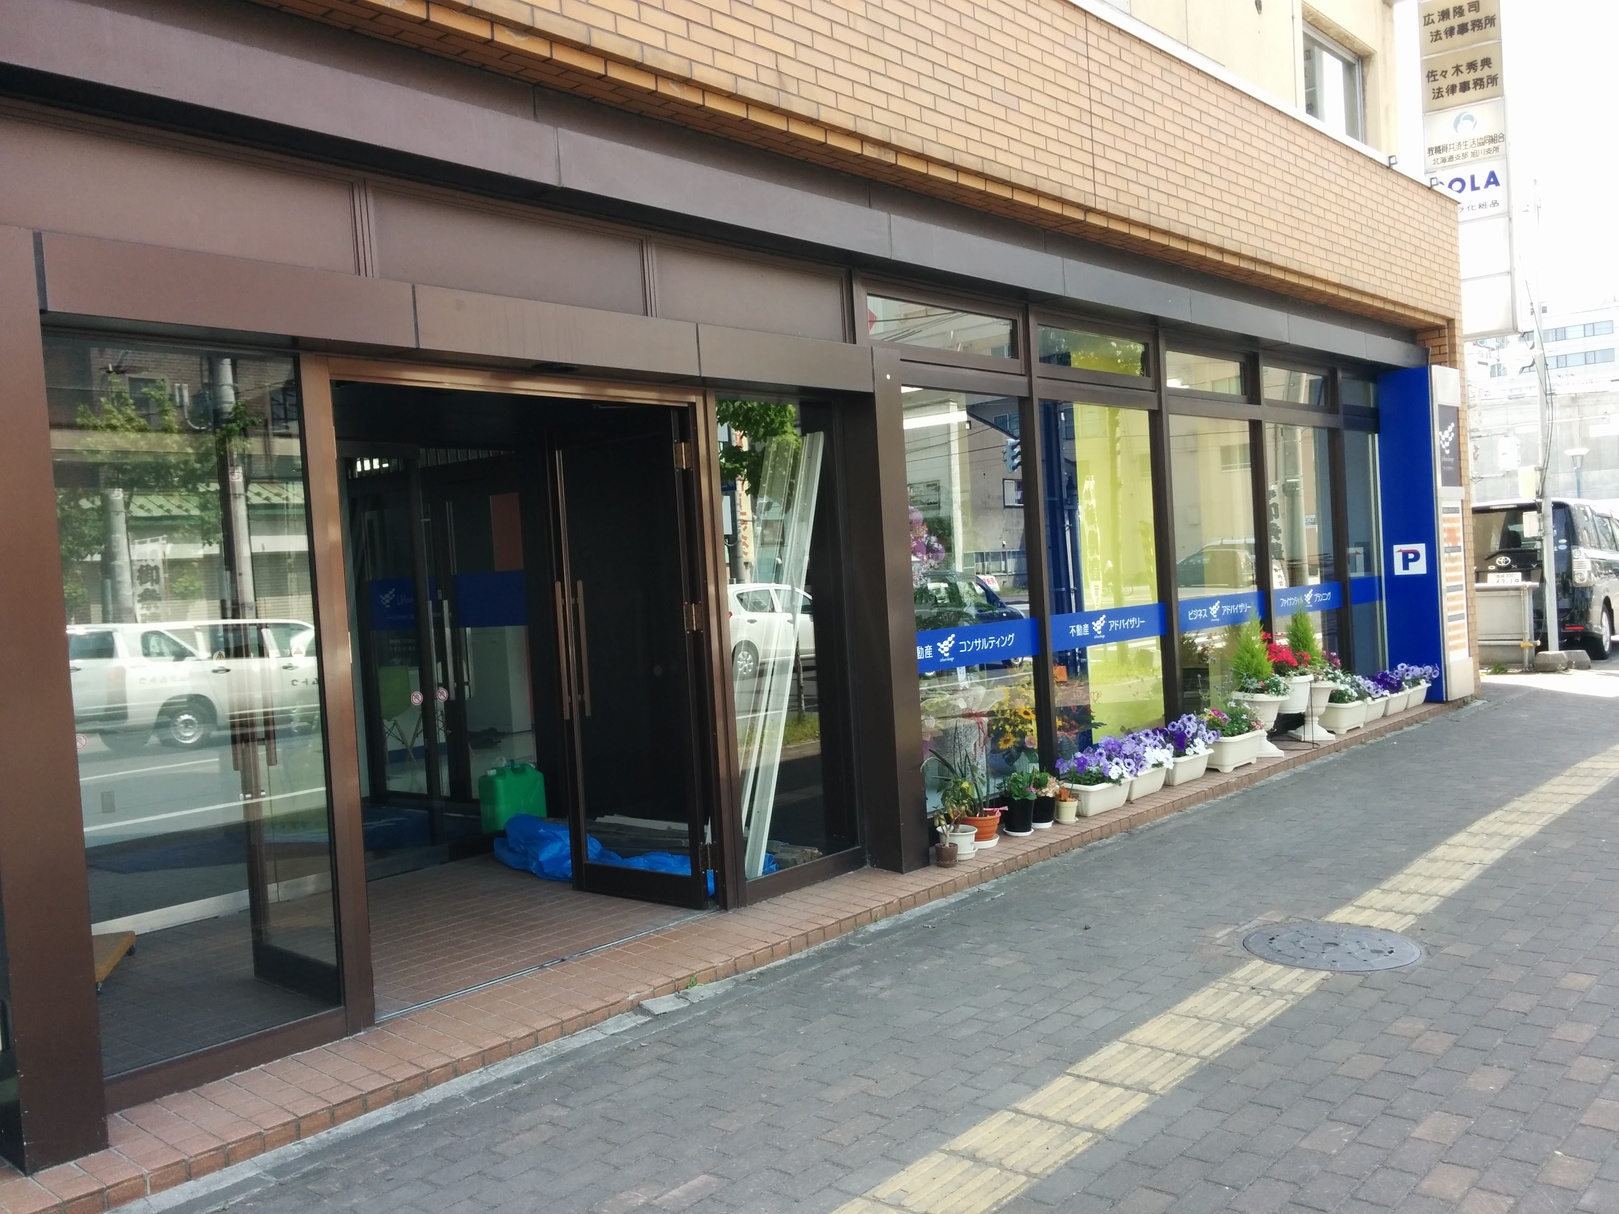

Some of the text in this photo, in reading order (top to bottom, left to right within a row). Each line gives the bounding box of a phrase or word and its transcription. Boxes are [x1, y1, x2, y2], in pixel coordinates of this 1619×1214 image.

[1422, 0, 1480, 27] 広瀬隆司
[1429, 14, 1497, 43] 法律事務所
[1426, 57, 1492, 83] 佐々木秀典
[1432, 73, 1499, 100] 法律事務所
[1438, 170, 1501, 194] OLA
[1401, 549, 1421, 571] P
[1188, 602, 1252, 621] ビジネス アドバイザリー
[1068, 616, 1146, 637] 不動産 アドバイザリー
[958, 632, 1015, 653] コンサルティング
